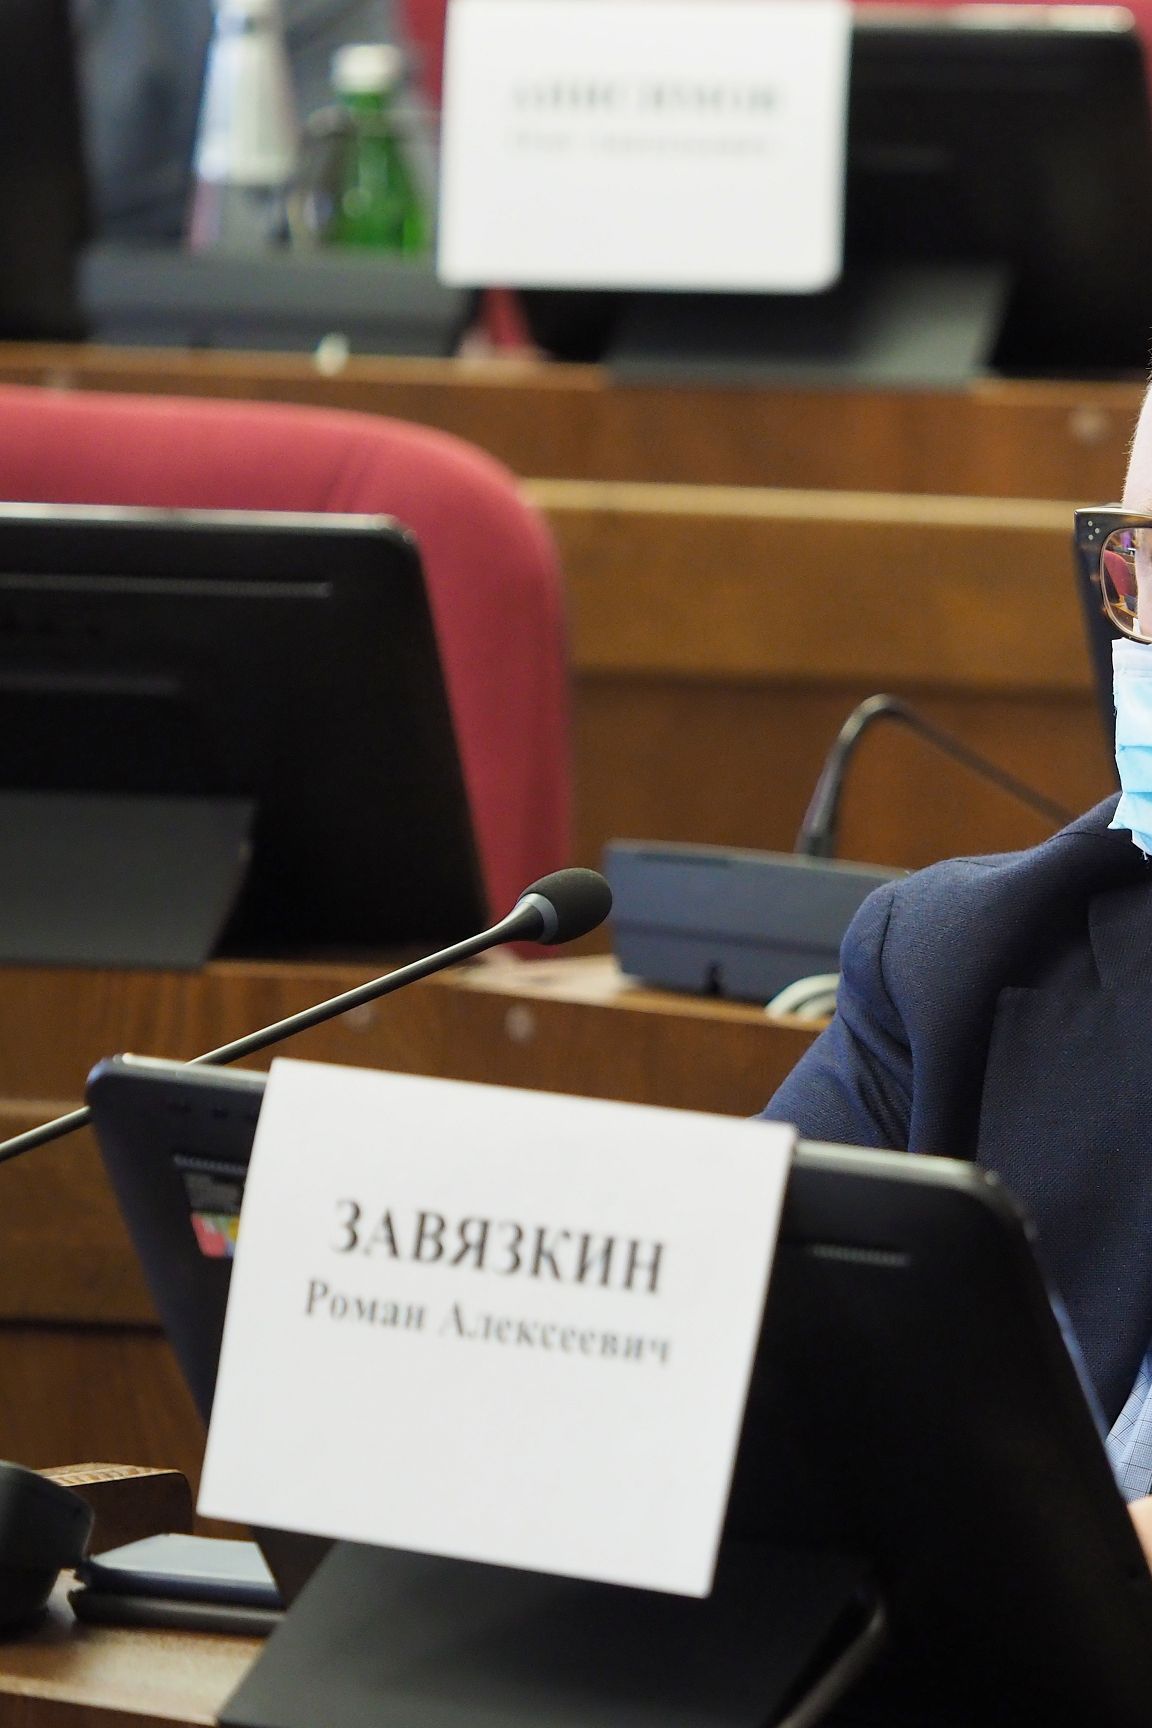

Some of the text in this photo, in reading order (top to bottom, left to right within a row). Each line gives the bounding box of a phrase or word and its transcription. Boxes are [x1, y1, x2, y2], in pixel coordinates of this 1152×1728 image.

[331, 1198, 666, 1294] ЗАВЯЗКИН
[305, 1278, 671, 1366] Роман Алексеевич
